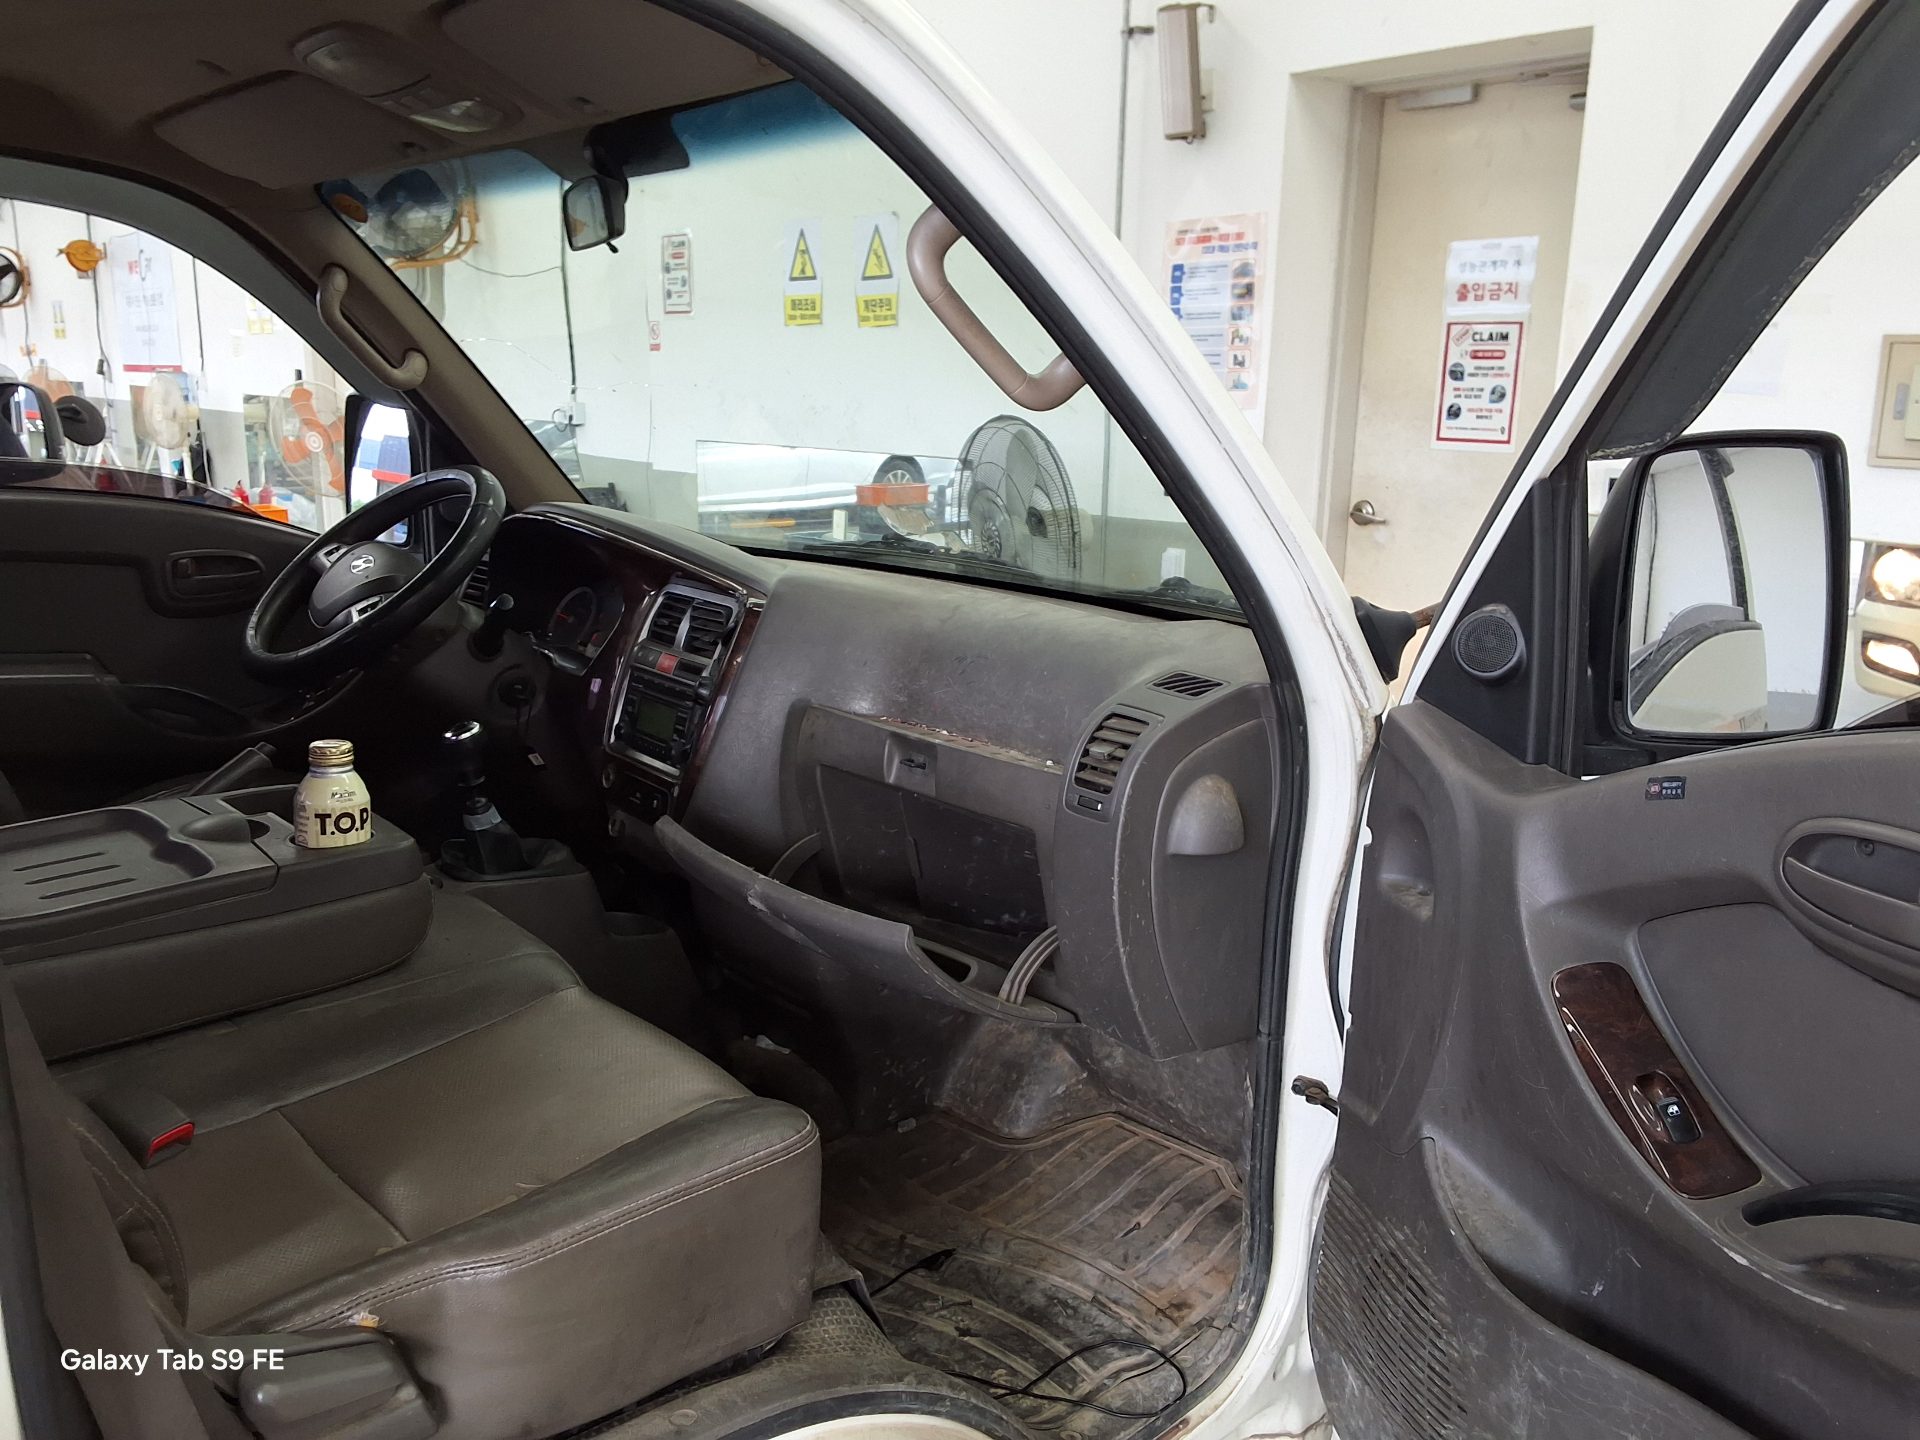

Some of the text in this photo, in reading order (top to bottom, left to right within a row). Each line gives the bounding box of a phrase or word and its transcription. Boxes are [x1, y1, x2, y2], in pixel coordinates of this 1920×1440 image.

[1456, 281, 1519, 302] 출입금지
[1472, 331, 1509, 342] CLAIM
[314, 807, 369, 836] T.O.P
